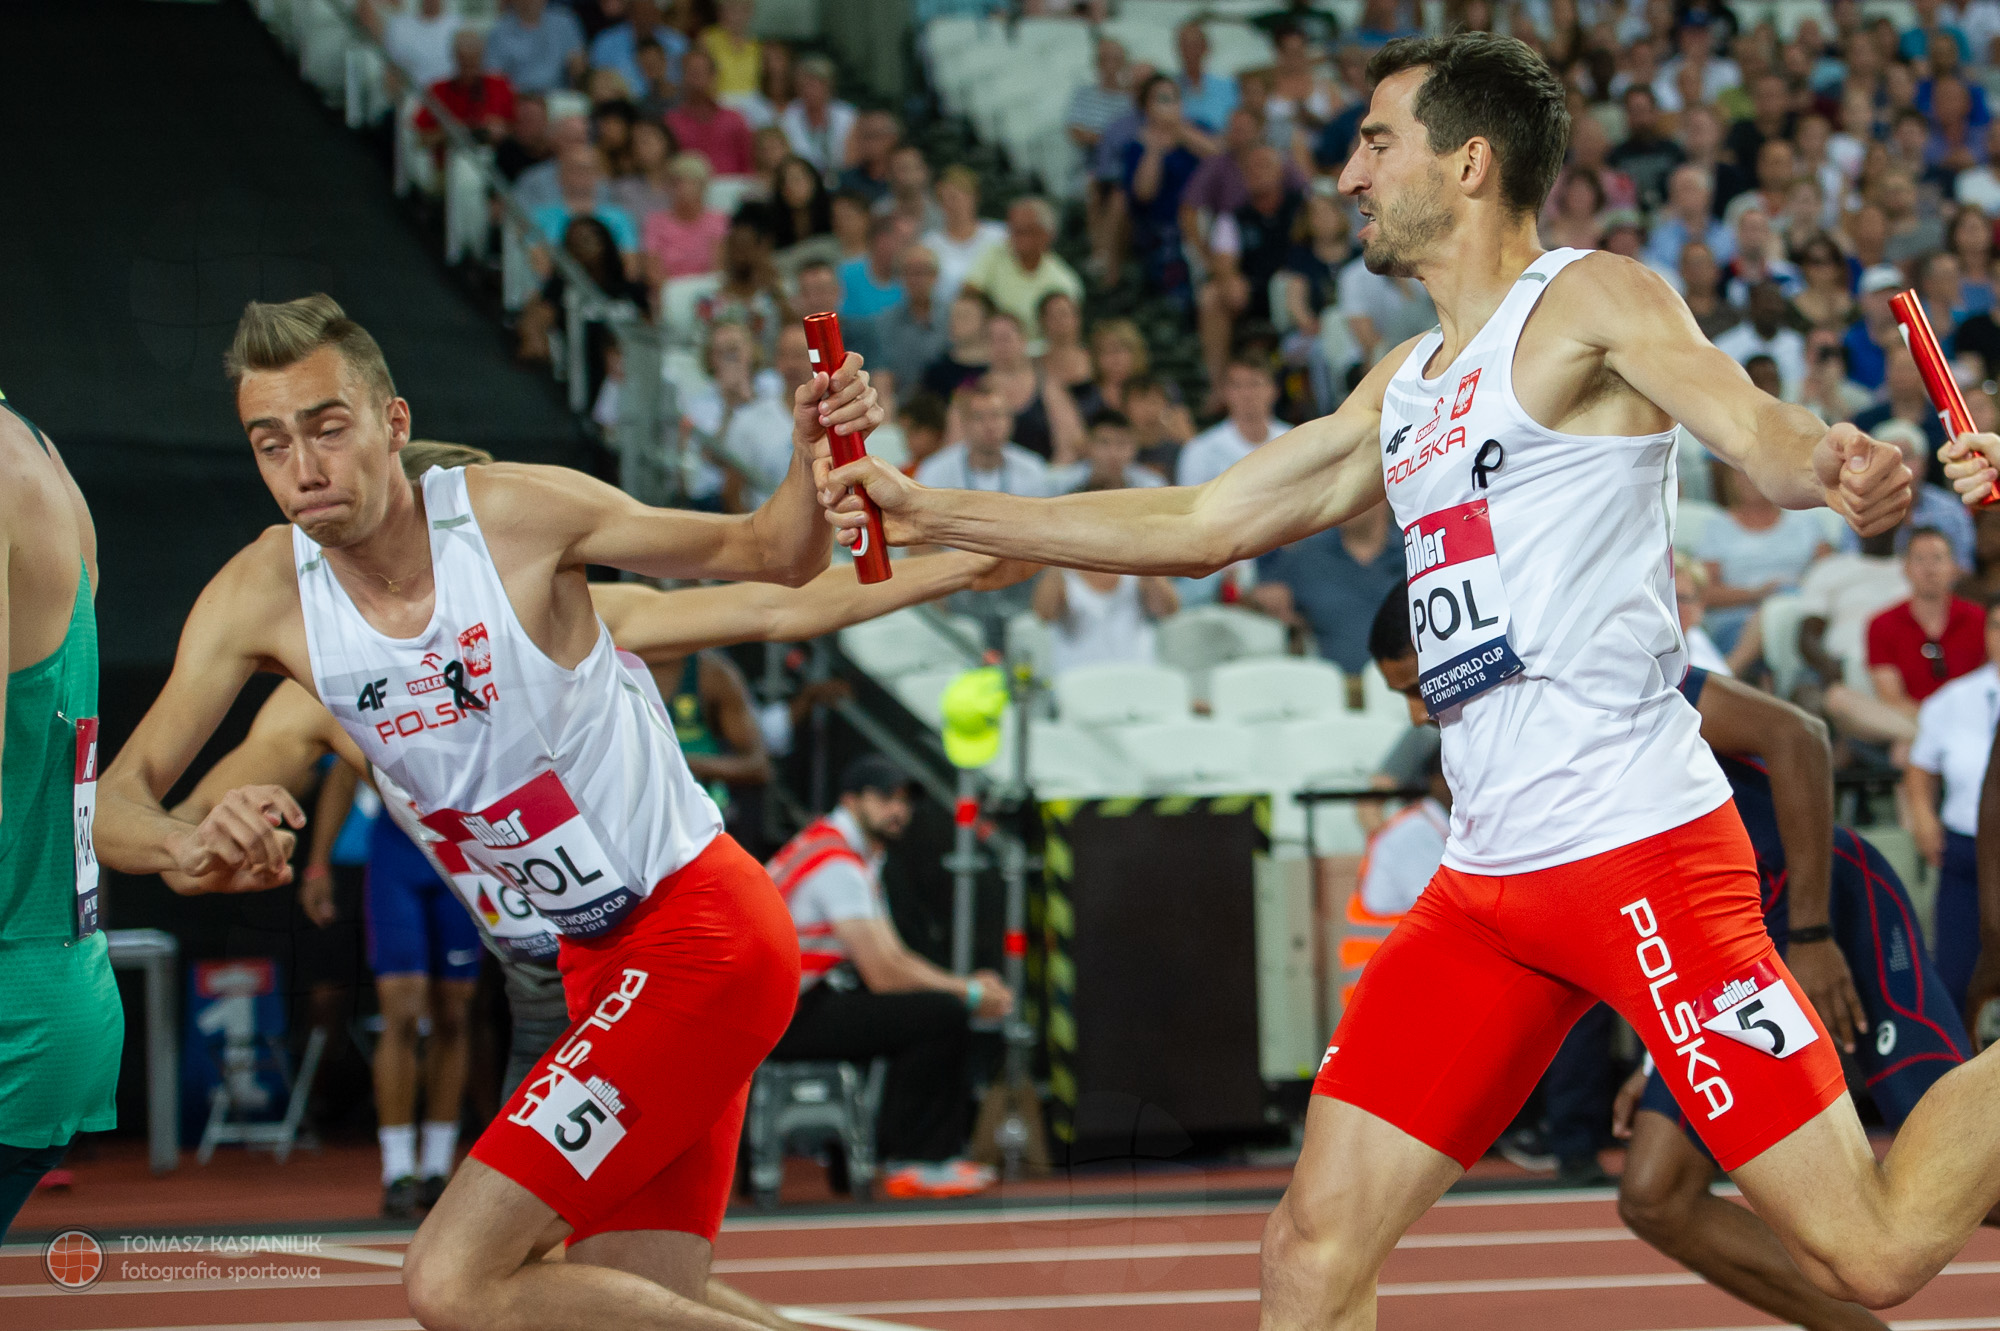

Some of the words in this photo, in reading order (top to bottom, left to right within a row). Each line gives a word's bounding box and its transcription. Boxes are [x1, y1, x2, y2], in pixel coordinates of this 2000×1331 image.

[1386, 424, 1413, 456] 4F
[1386, 426, 1466, 493] POLSKA
[1404, 524, 1447, 582] üller
[459, 624, 484, 643] OLSKA
[1413, 579, 1499, 653] POL
[1447, 657, 1484, 683] WORLD
[1482, 646, 1504, 665] CUP
[356, 678, 388, 712] 4F
[1431, 683, 1462, 705] LONDON
[1462, 672, 1486, 690] 2018
[462, 808, 531, 847] üller
[499, 845, 604, 896] POL
[564, 907, 605, 926] WORLD
[602, 895, 627, 913] CUP
[583, 918, 608, 933] 2018
[1619, 897, 1735, 1121] POLSKA
[1712, 976, 1759, 1013] müller
[1736, 998, 1786, 1056] 5
[507, 968, 649, 1127] POLSKA
[1317, 1045, 1340, 1073] F
[584, 1074, 626, 1116] müller
[554, 1099, 608, 1153] 5
